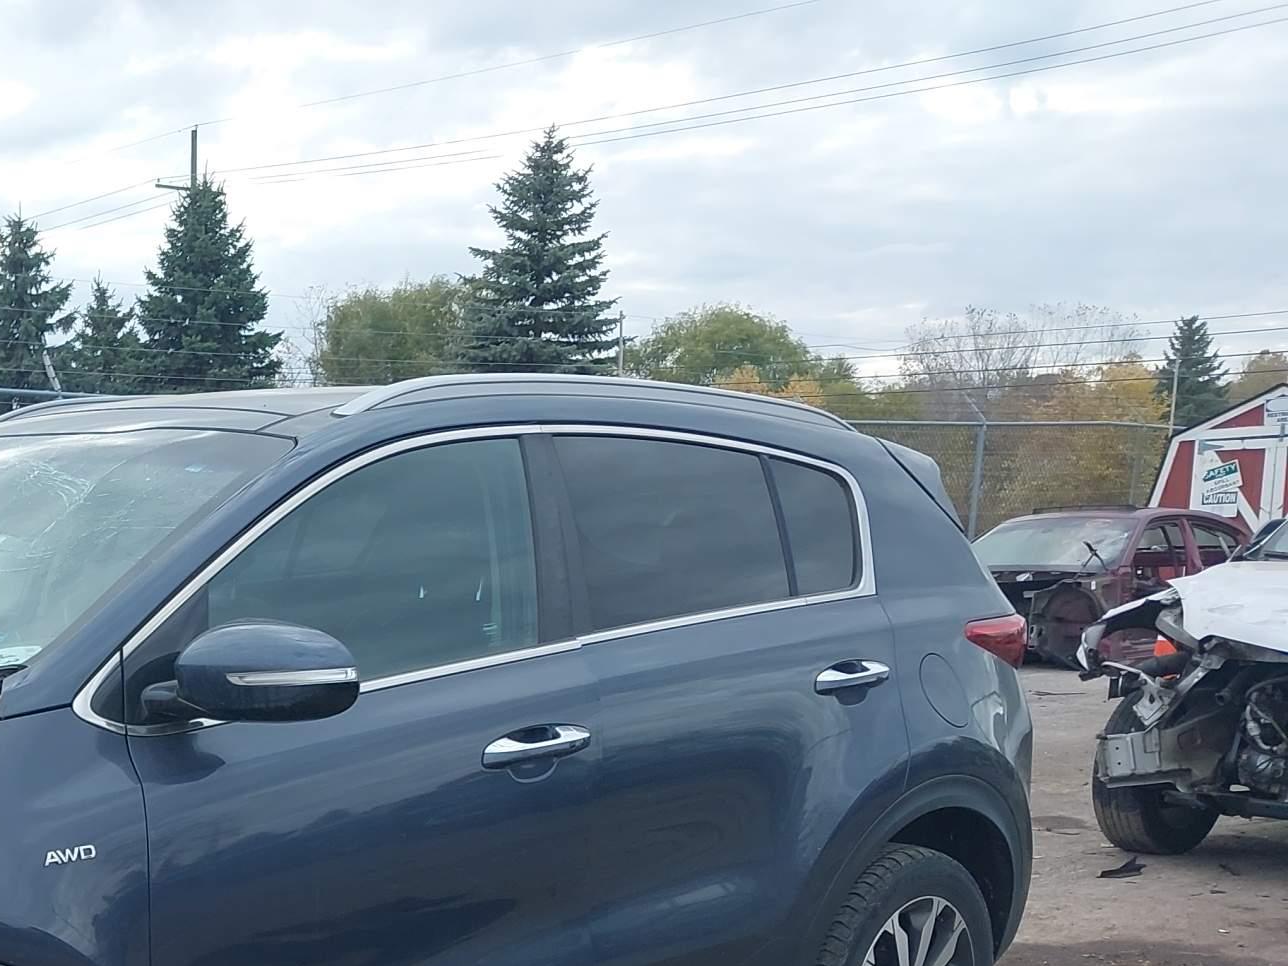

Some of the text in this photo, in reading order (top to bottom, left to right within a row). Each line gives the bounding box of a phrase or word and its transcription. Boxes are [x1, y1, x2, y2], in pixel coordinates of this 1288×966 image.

[1202, 462, 1237, 480] SAFETY
[1203, 493, 1237, 504] CAUTION
[44, 844, 97, 867] AWD
